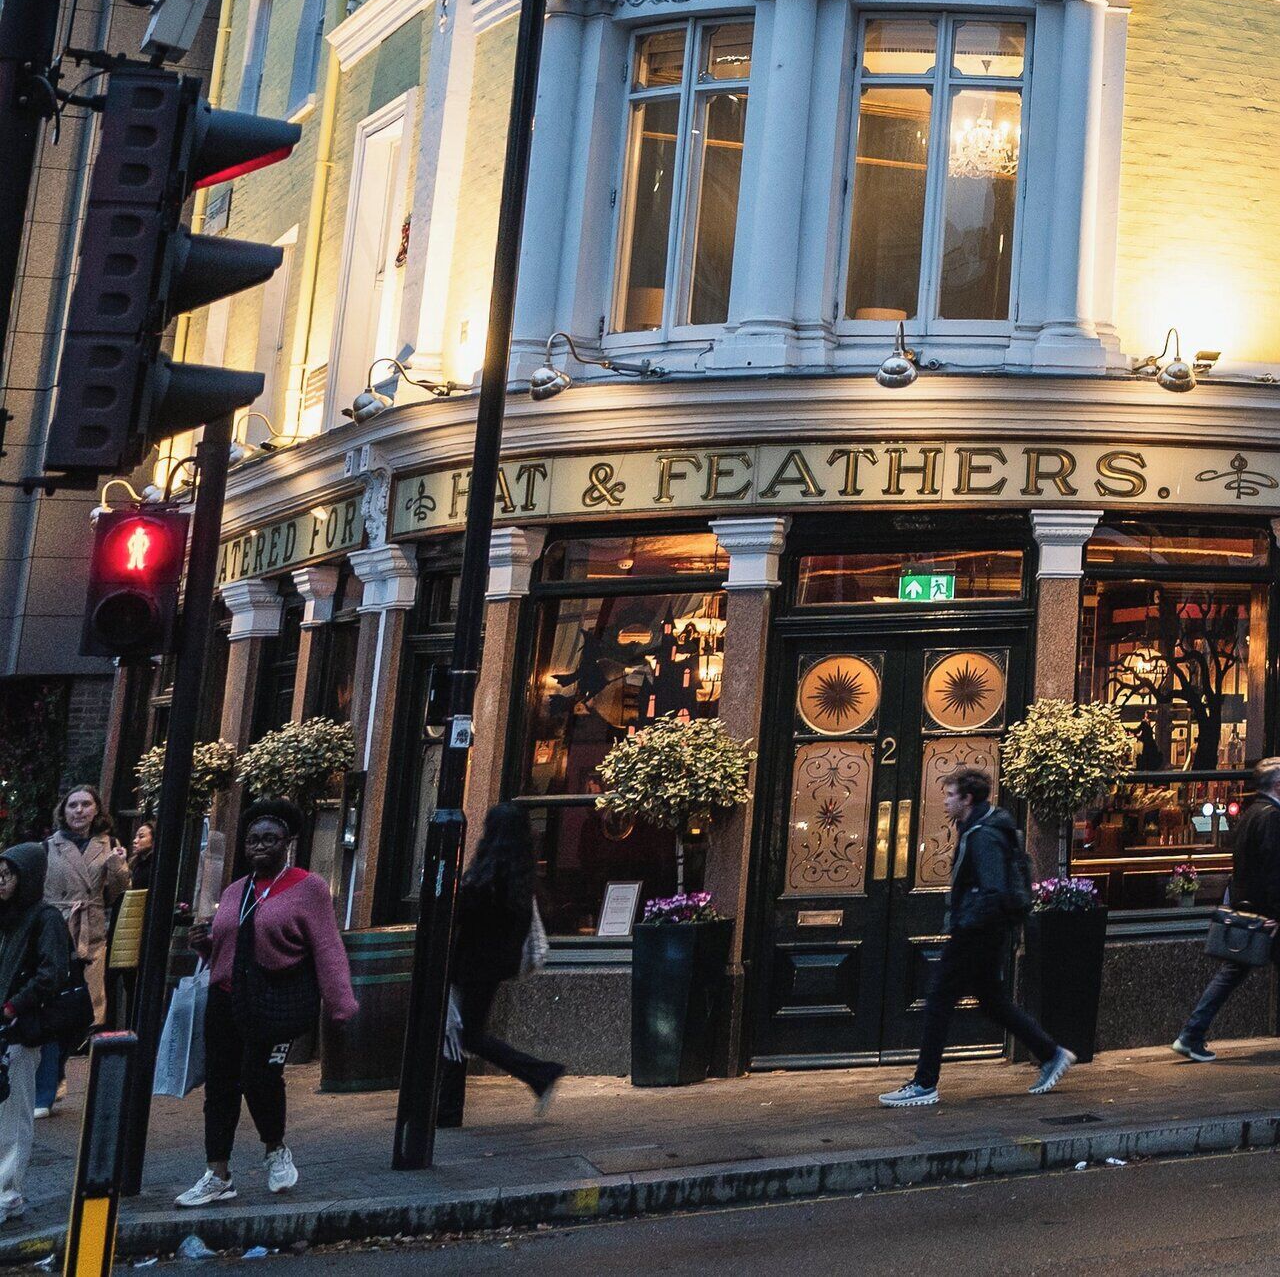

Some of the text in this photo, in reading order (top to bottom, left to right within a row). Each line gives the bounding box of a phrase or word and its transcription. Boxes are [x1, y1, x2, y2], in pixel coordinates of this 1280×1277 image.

[582, 461, 627, 508] &
[309, 499, 357, 555] FOR
[879, 737, 898, 766] 2
